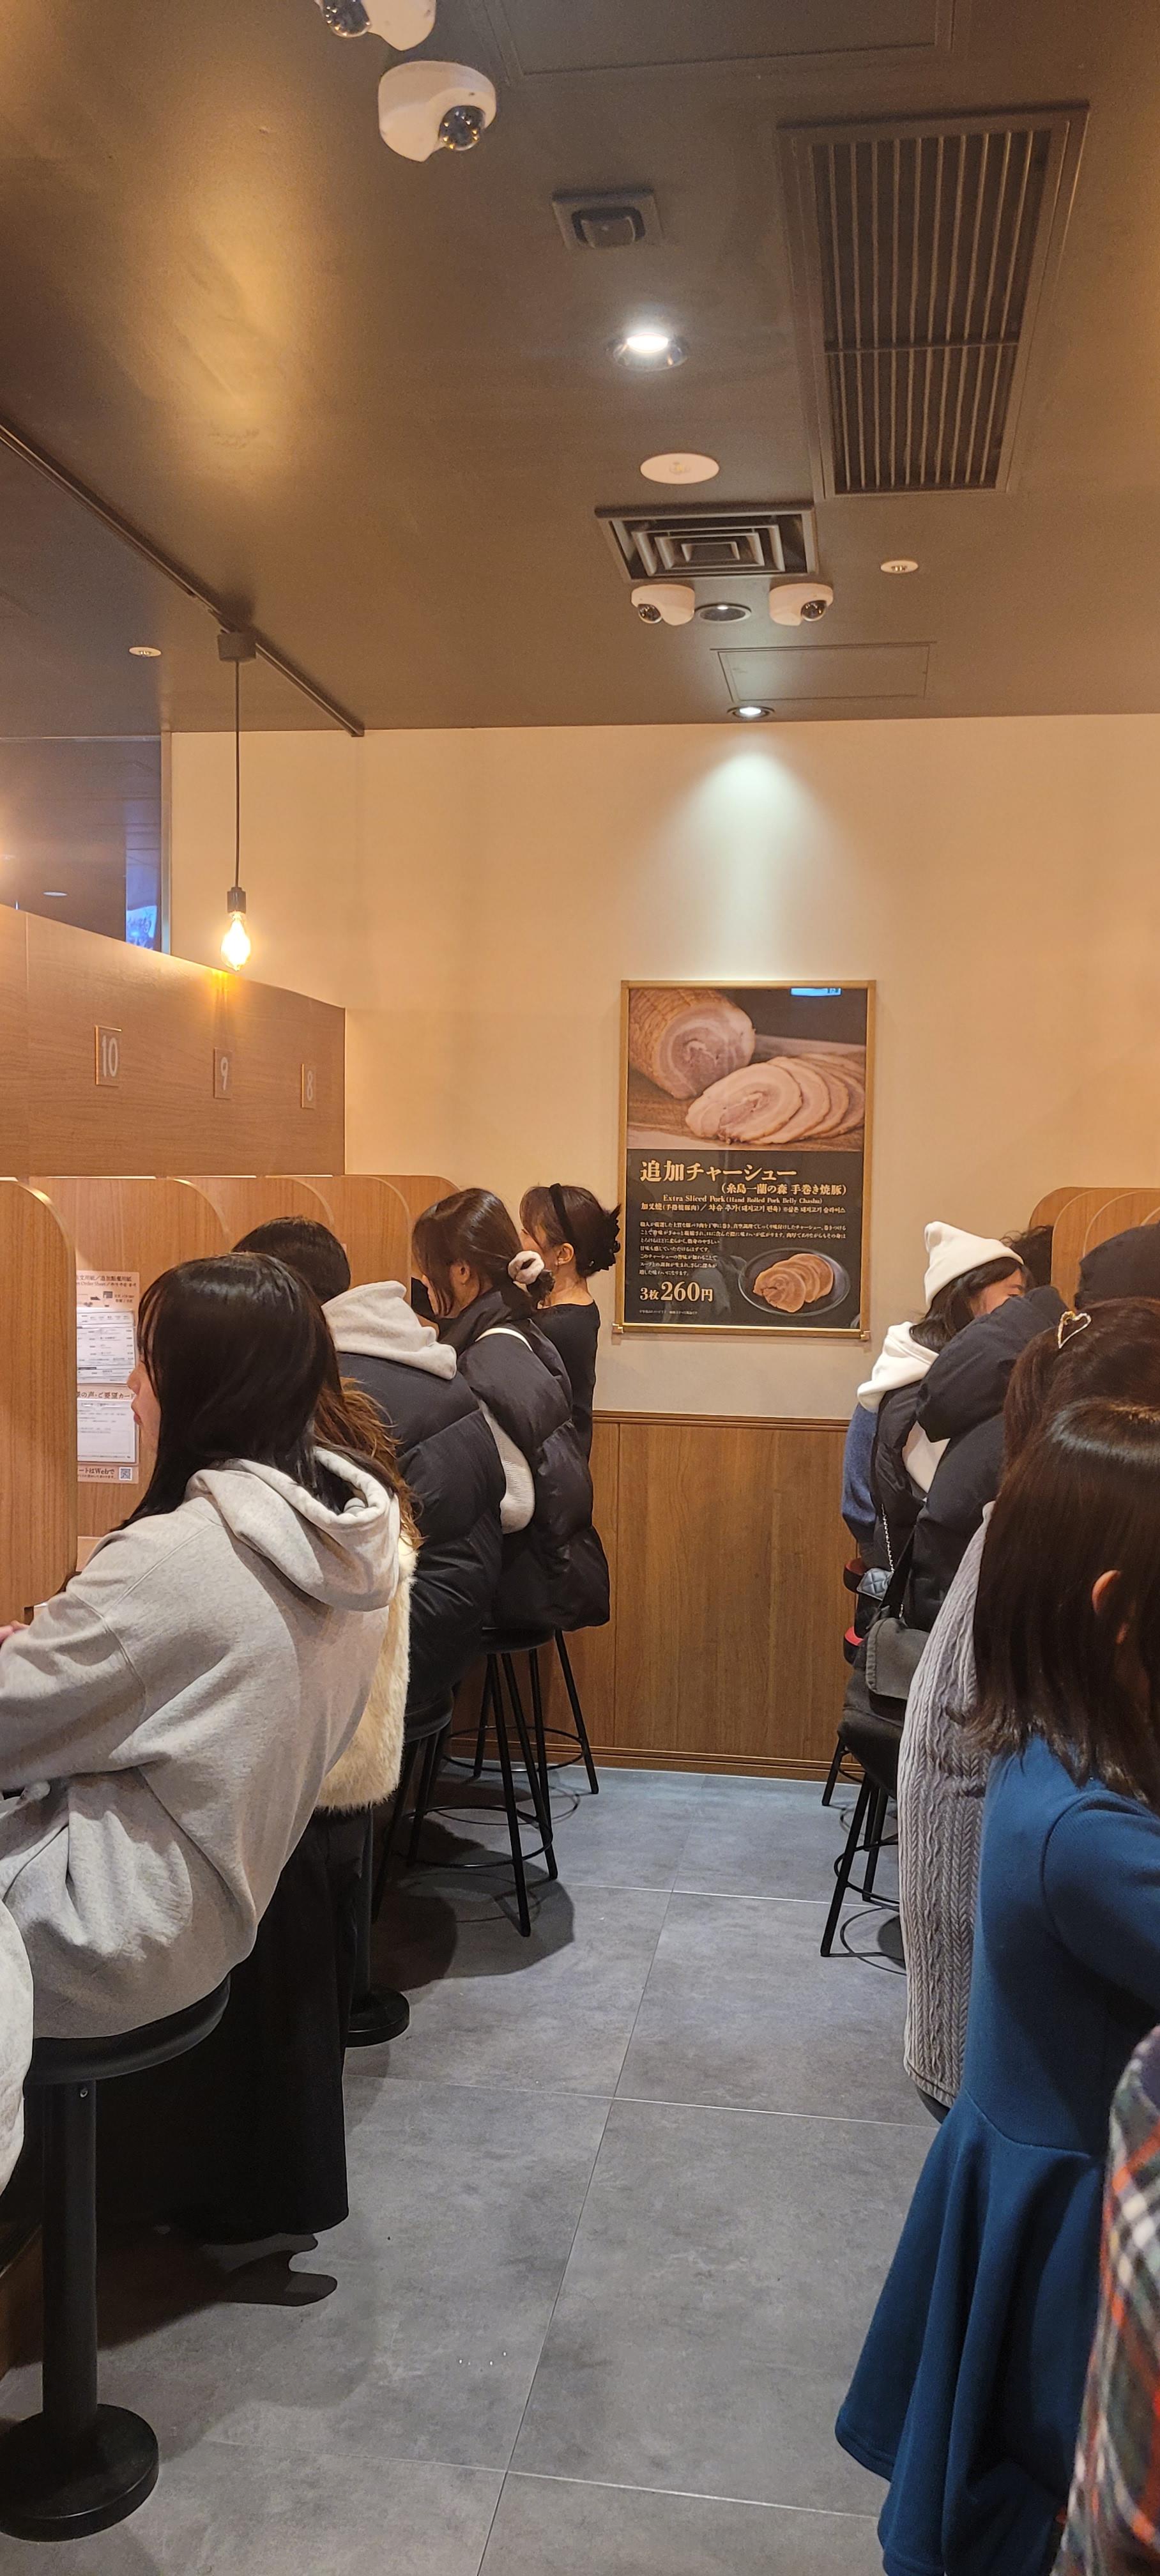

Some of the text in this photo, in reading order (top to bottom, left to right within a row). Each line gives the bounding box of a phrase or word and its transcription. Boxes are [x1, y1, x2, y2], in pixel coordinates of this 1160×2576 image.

[102, 1035, 118, 1078] 10
[220, 1057, 228, 1091] 9
[307, 1070, 313, 1101] 8
[639, 1160, 798, 1183] 追加チャーシュー
[790, 1183, 848, 1196] 手巻き焼豚)
[639, 1281, 714, 1302] 3枚260円
